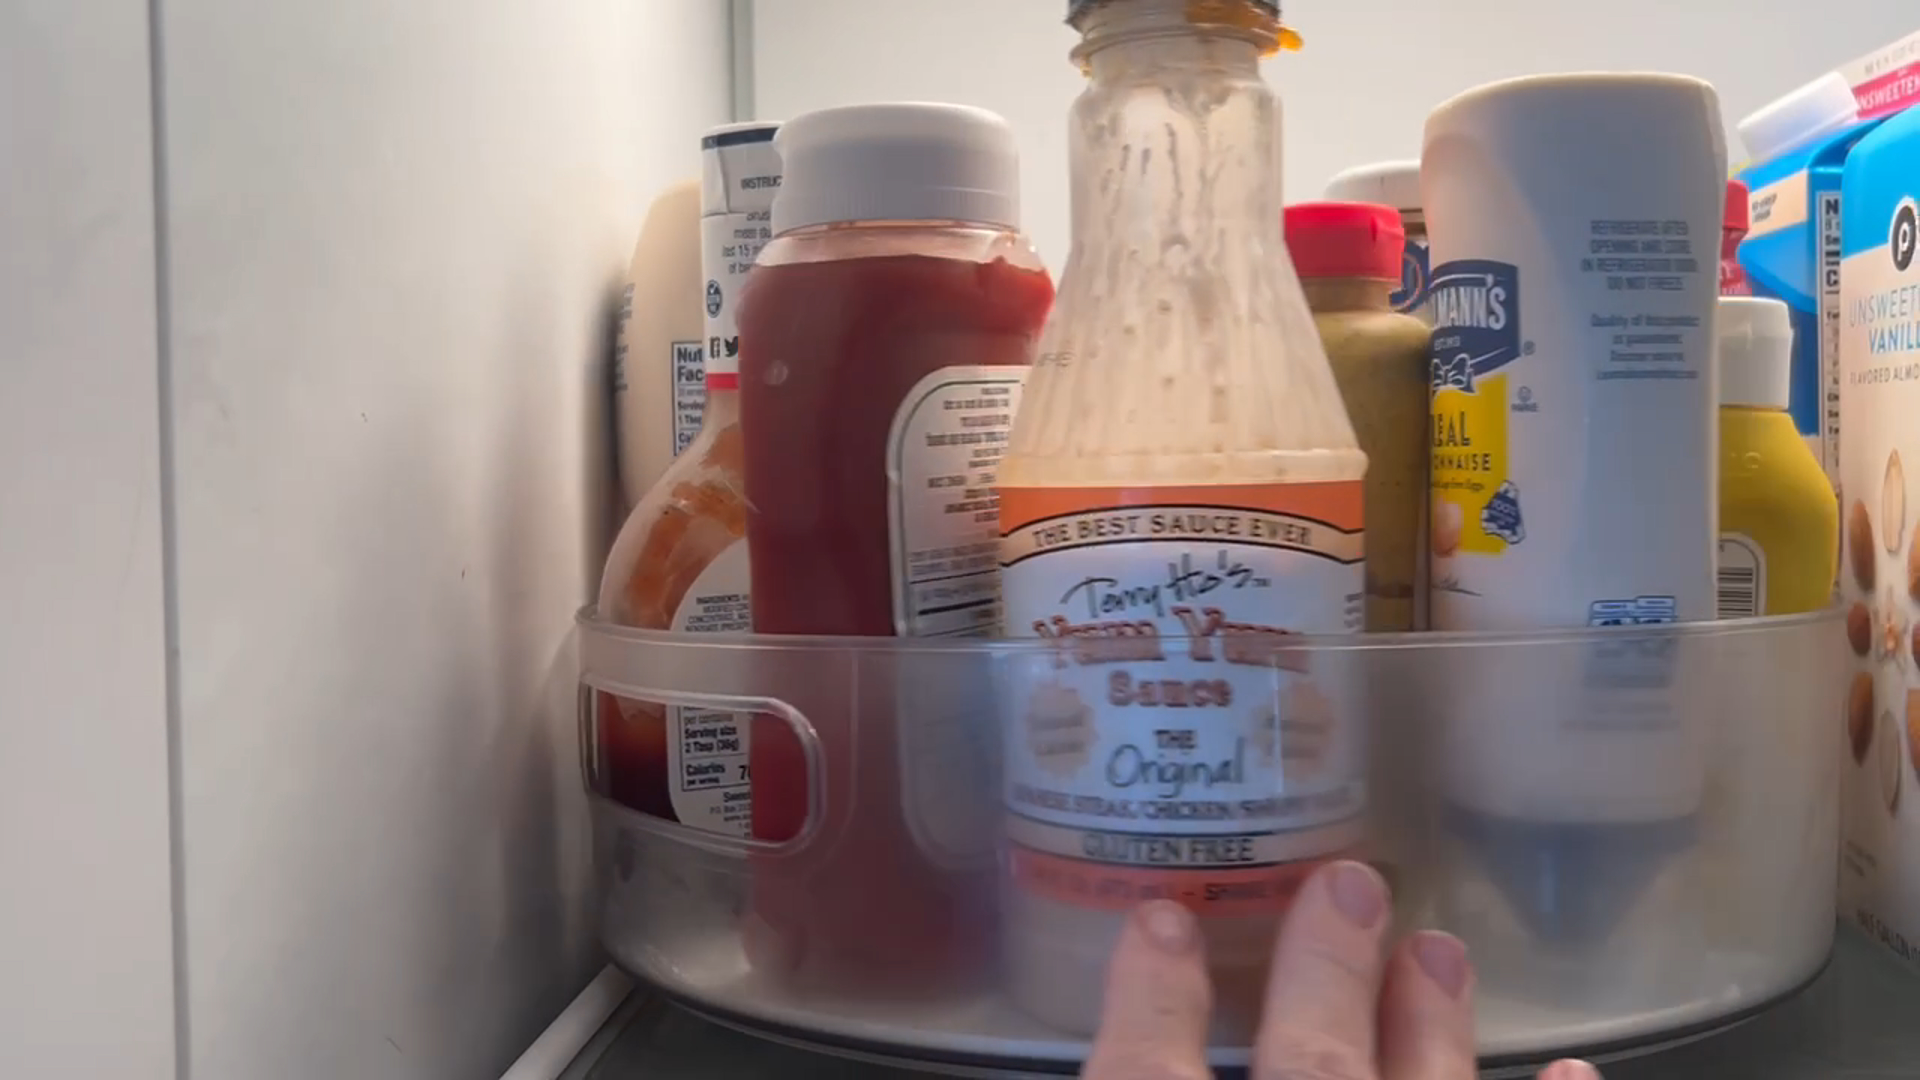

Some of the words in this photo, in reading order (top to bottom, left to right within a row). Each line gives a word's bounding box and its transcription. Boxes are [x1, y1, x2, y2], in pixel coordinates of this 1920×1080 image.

[1031, 523, 1072, 548] THE
[1075, 514, 1142, 540] BEST
[1149, 514, 1242, 538] SAUCE
[1246, 516, 1313, 547] EVER
[1106, 669, 1234, 708] Sauce
[685, 762, 726, 777] Calories
[1105, 735, 1245, 799] Original
[1081, 831, 1182, 862] GLUTEN
[1188, 837, 1258, 862] FREE
